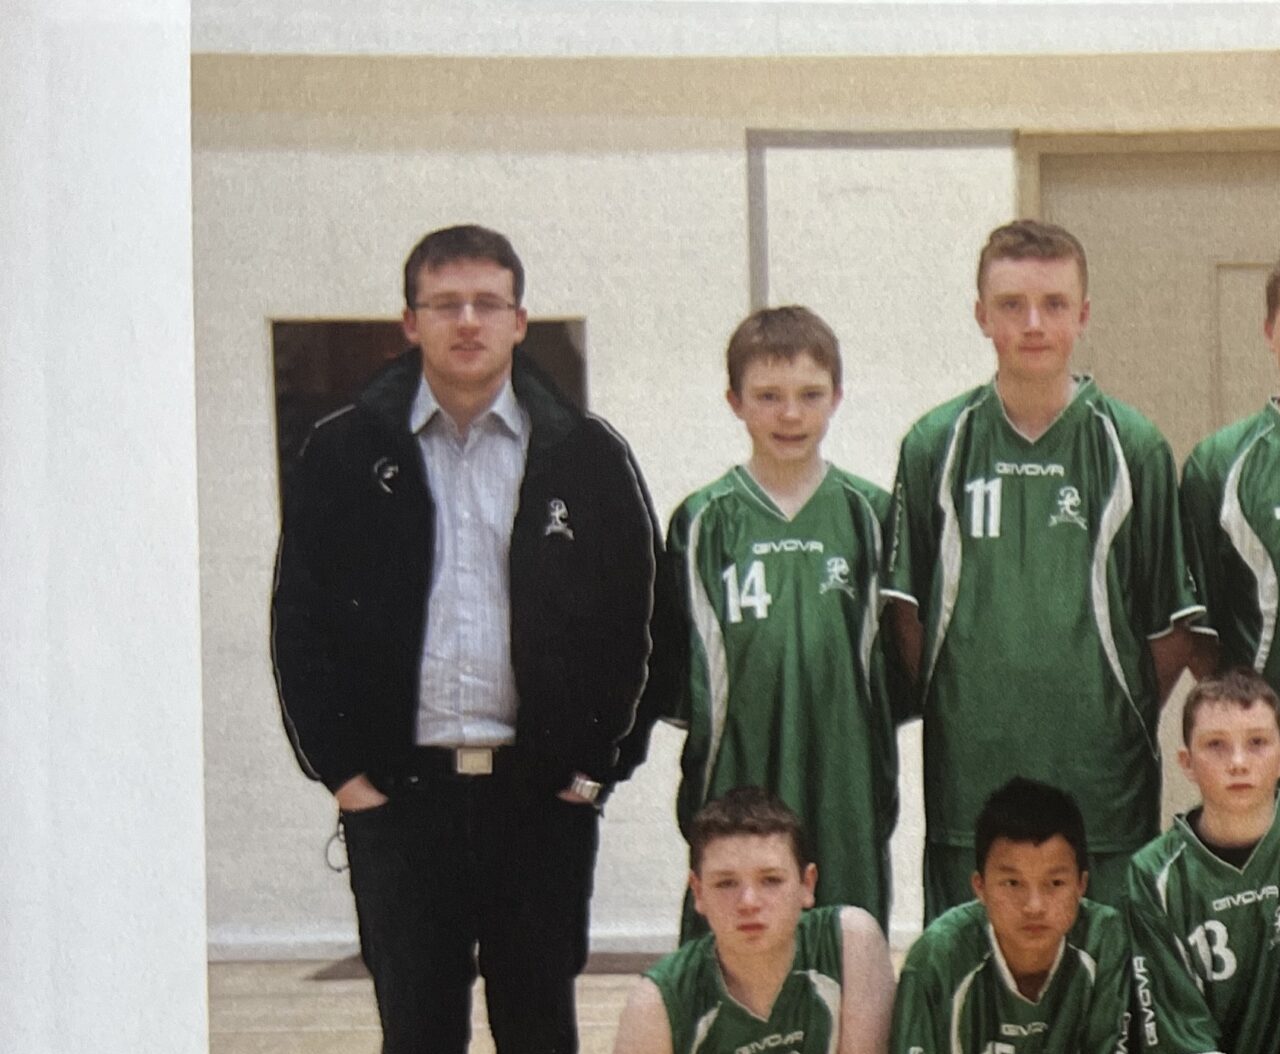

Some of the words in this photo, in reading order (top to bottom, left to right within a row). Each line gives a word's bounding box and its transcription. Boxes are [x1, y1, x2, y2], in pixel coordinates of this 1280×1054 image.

[995, 461, 1065, 478] GIVOVA
[964, 478, 1002, 538] 11
[752, 538, 824, 555] GIVOVA
[722, 560, 772, 623] 14
[1212, 885, 1280, 912] GIVOVA
[1187, 920, 1237, 982] 13
[1133, 956, 1158, 1046] GIVOVA
